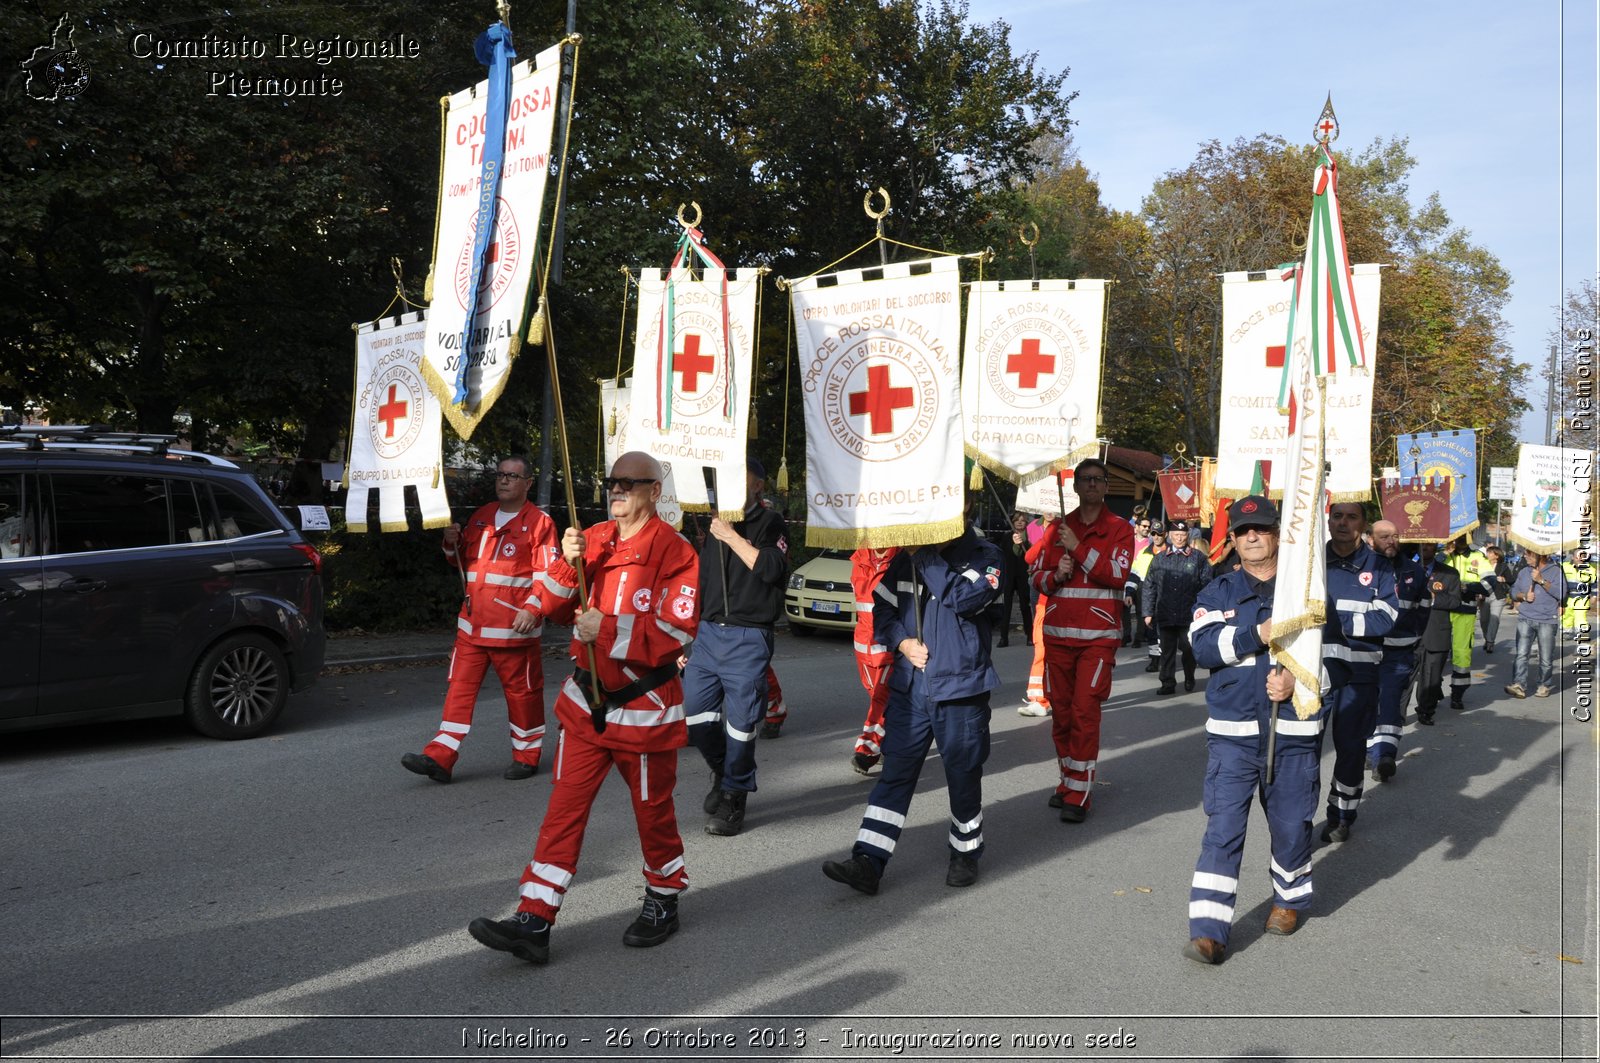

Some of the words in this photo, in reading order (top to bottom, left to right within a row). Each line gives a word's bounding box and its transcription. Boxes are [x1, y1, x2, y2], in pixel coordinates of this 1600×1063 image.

[802, 305, 829, 321] CORPO
[833, 297, 881, 317] VOLONTARI
[885, 296, 905, 311] DEL
[907, 290, 953, 309] SOCCORSO
[974, 314, 1006, 355] CROCE
[1007, 301, 1050, 320] ROSSA
[1053, 305, 1091, 355] ITALIANA
[1001, 331, 1013, 343] DI
[1013, 319, 1054, 335] GINEVRA
[1053, 330, 1066, 344] 22
[1229, 311, 1265, 346] CROCE
[804, 337, 839, 394] CROCE
[837, 313, 896, 346] ROSSA
[857, 340, 914, 363] GINEVRA
[841, 355, 856, 371] DI
[912, 360, 930, 378] 22
[987, 341, 1017, 405] CONVENZIONE
[1062, 344, 1075, 388] AGOSTO
[359, 366, 379, 409] CROCE
[377, 348, 406, 368] ROSSA
[410, 383, 421, 396] 22
[1038, 384, 1063, 405] 1864
[919, 378, 937, 432] AGOSTO
[1326, 393, 1363, 409] CALE
[827, 373, 871, 457] CONVENZIONE
[971, 414, 1072, 428] SOTTOCOMITATO
[1071, 416, 1082, 428] DI
[682, 435, 692, 446] DI
[694, 425, 737, 439] LOCALE
[893, 428, 924, 456] 1864
[971, 430, 1079, 448] CARMAGNOLA
[650, 442, 725, 462] MONCALIERI
[1432, 440, 1474, 459] NICHELINO
[351, 470, 381, 482] GRUPPO
[391, 469, 403, 480] LA
[813, 487, 926, 509] CASTAGNOLE
[1282, 434, 1318, 546] ITALIANA
